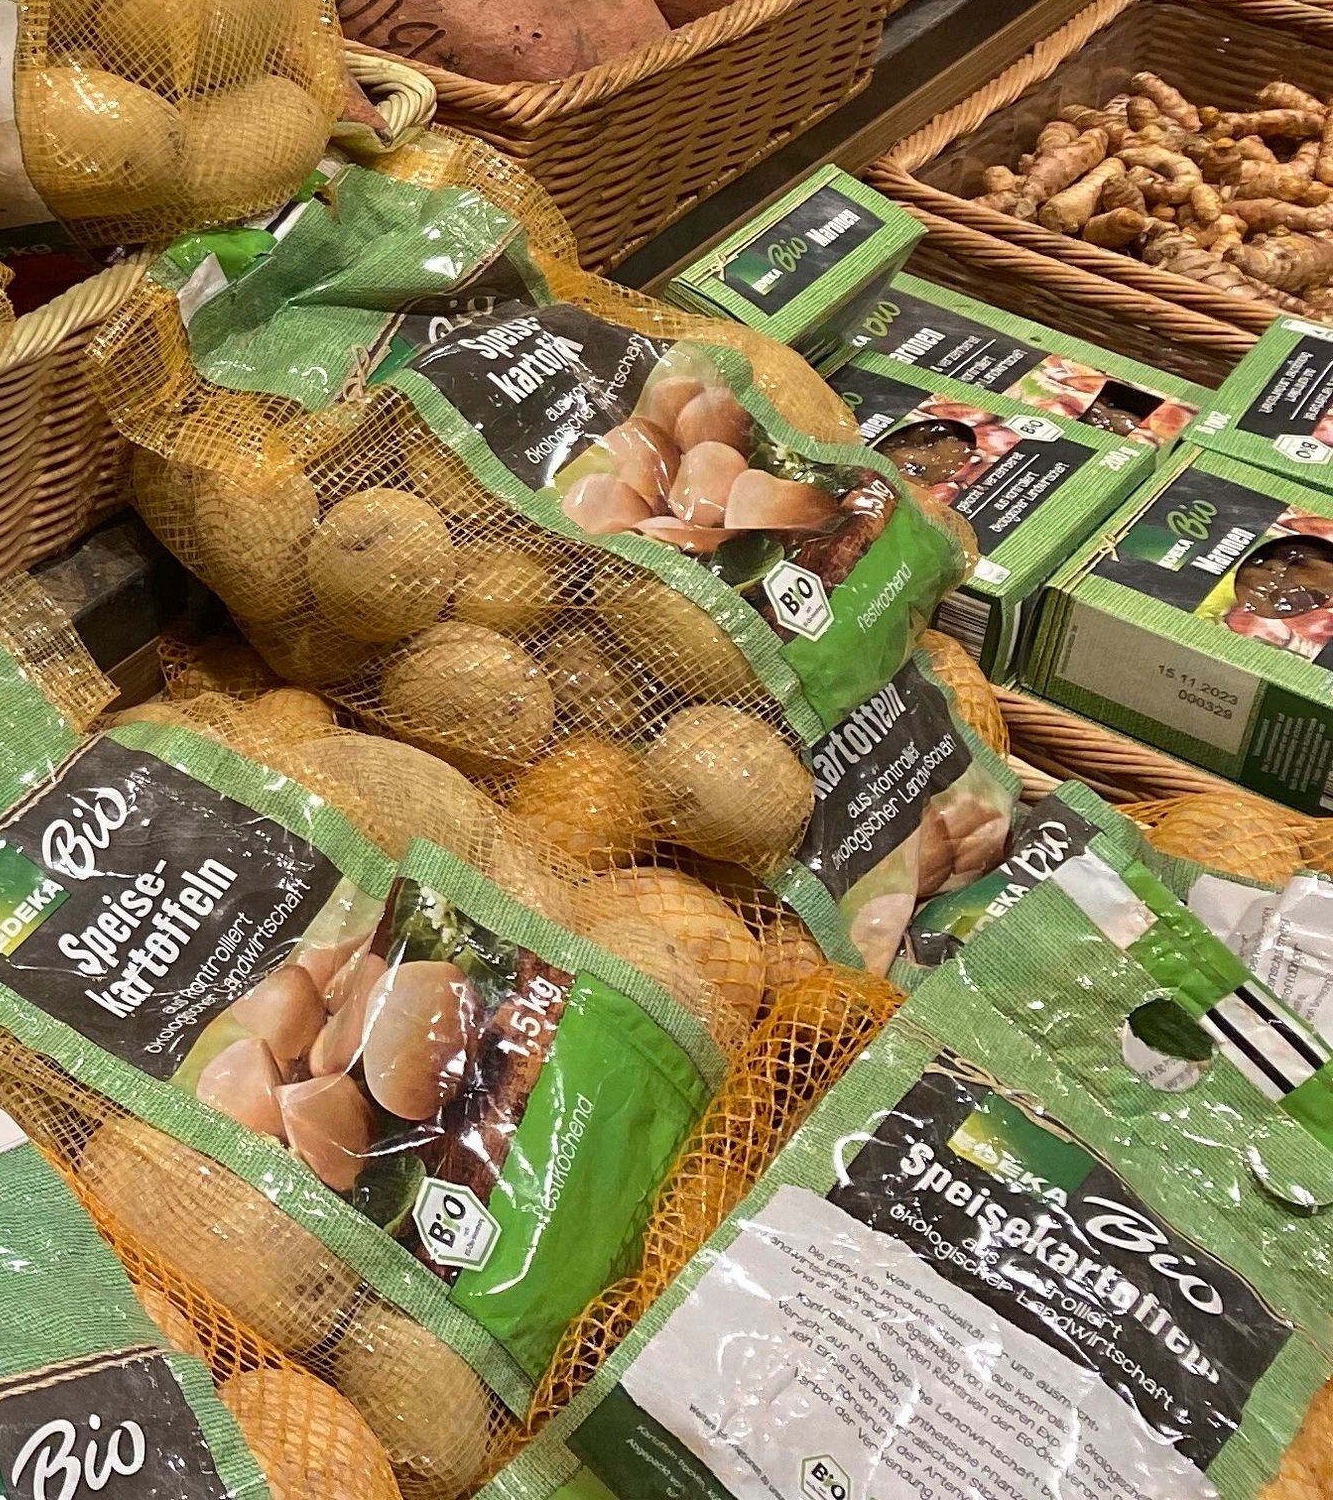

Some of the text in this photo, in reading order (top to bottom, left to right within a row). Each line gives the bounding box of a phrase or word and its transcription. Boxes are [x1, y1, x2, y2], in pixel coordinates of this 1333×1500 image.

[805, 208, 862, 248] Maronen
[768, 235, 808, 273] Bio
[888, 327, 946, 364] aronen
[1167, 499, 1218, 541] Bio
[1190, 526, 1257, 577] Maronen
[1157, 664, 1239, 706] 15.11.2023
[1177, 689, 1233, 720] 000329
[847, 791, 873, 819] aus
[42, 785, 131, 881] Bio
[58, 858, 169, 977] Speise-
[221, 877, 312, 995] Landwirtschaft
[85, 856, 240, 1019] kartoffeln
[496, 974, 564, 1060] 1,5 kg
[1083, 1196, 1225, 1316] Bio
[829, 1332, 851, 1358] auf
[961, 1367, 984, 1393] von
[1011, 1359, 1035, 1384] uns
[858, 1382, 879, 1407] von
[835, 1406, 857, 1433] der
[991, 1410, 1014, 1432] der
[896, 1442, 922, 1467] der
